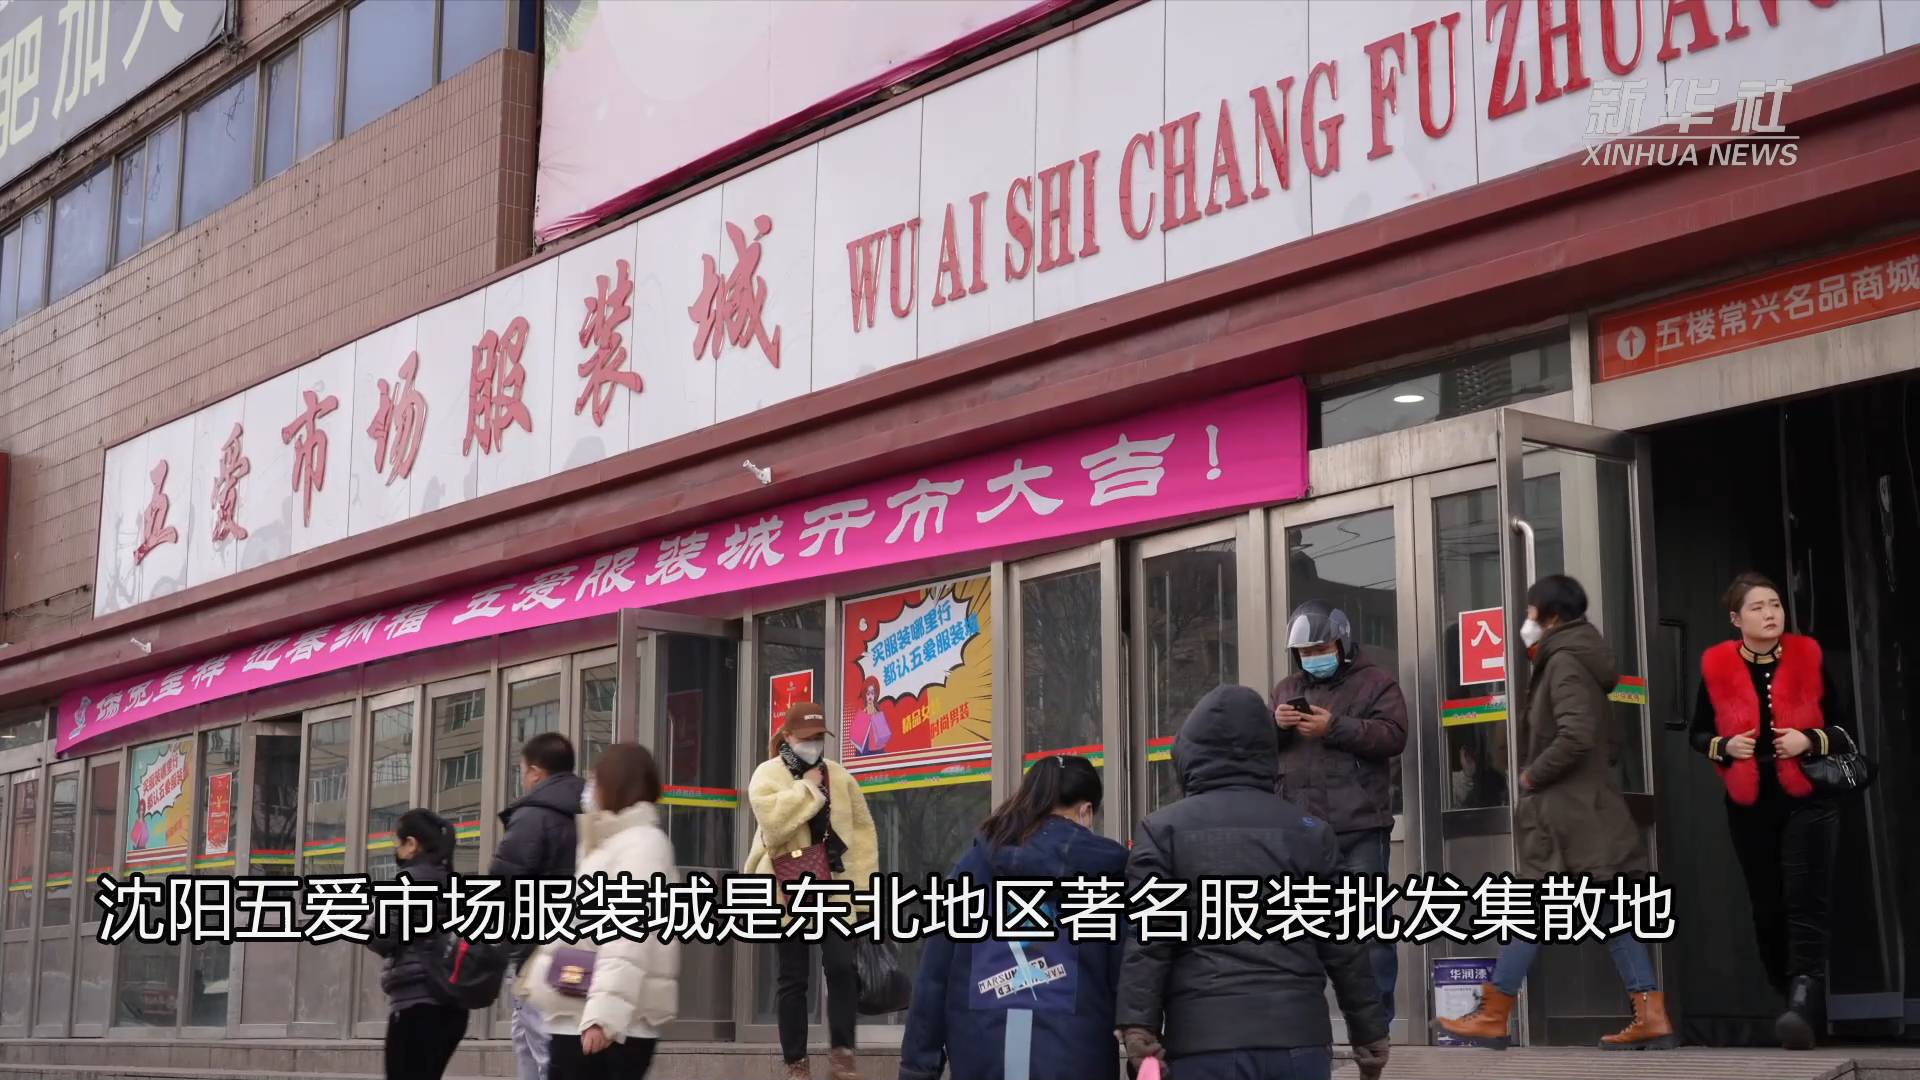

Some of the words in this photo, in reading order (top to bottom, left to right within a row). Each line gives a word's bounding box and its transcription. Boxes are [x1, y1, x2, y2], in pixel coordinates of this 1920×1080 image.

[847, 217, 920, 333] WU
[931, 191, 988, 306] AI
[1005, 150, 1100, 282] SHI
[1118, 59, 1344, 240] CHANG
[1364, 11, 1460, 161] FU
[1655, 254, 1920, 353] 五楼常兴名品商城
[132, 214, 782, 566] 五爱市场服装城
[242, 600, 438, 673] 迎春纳福
[871, 600, 953, 667] 买服装哪里行
